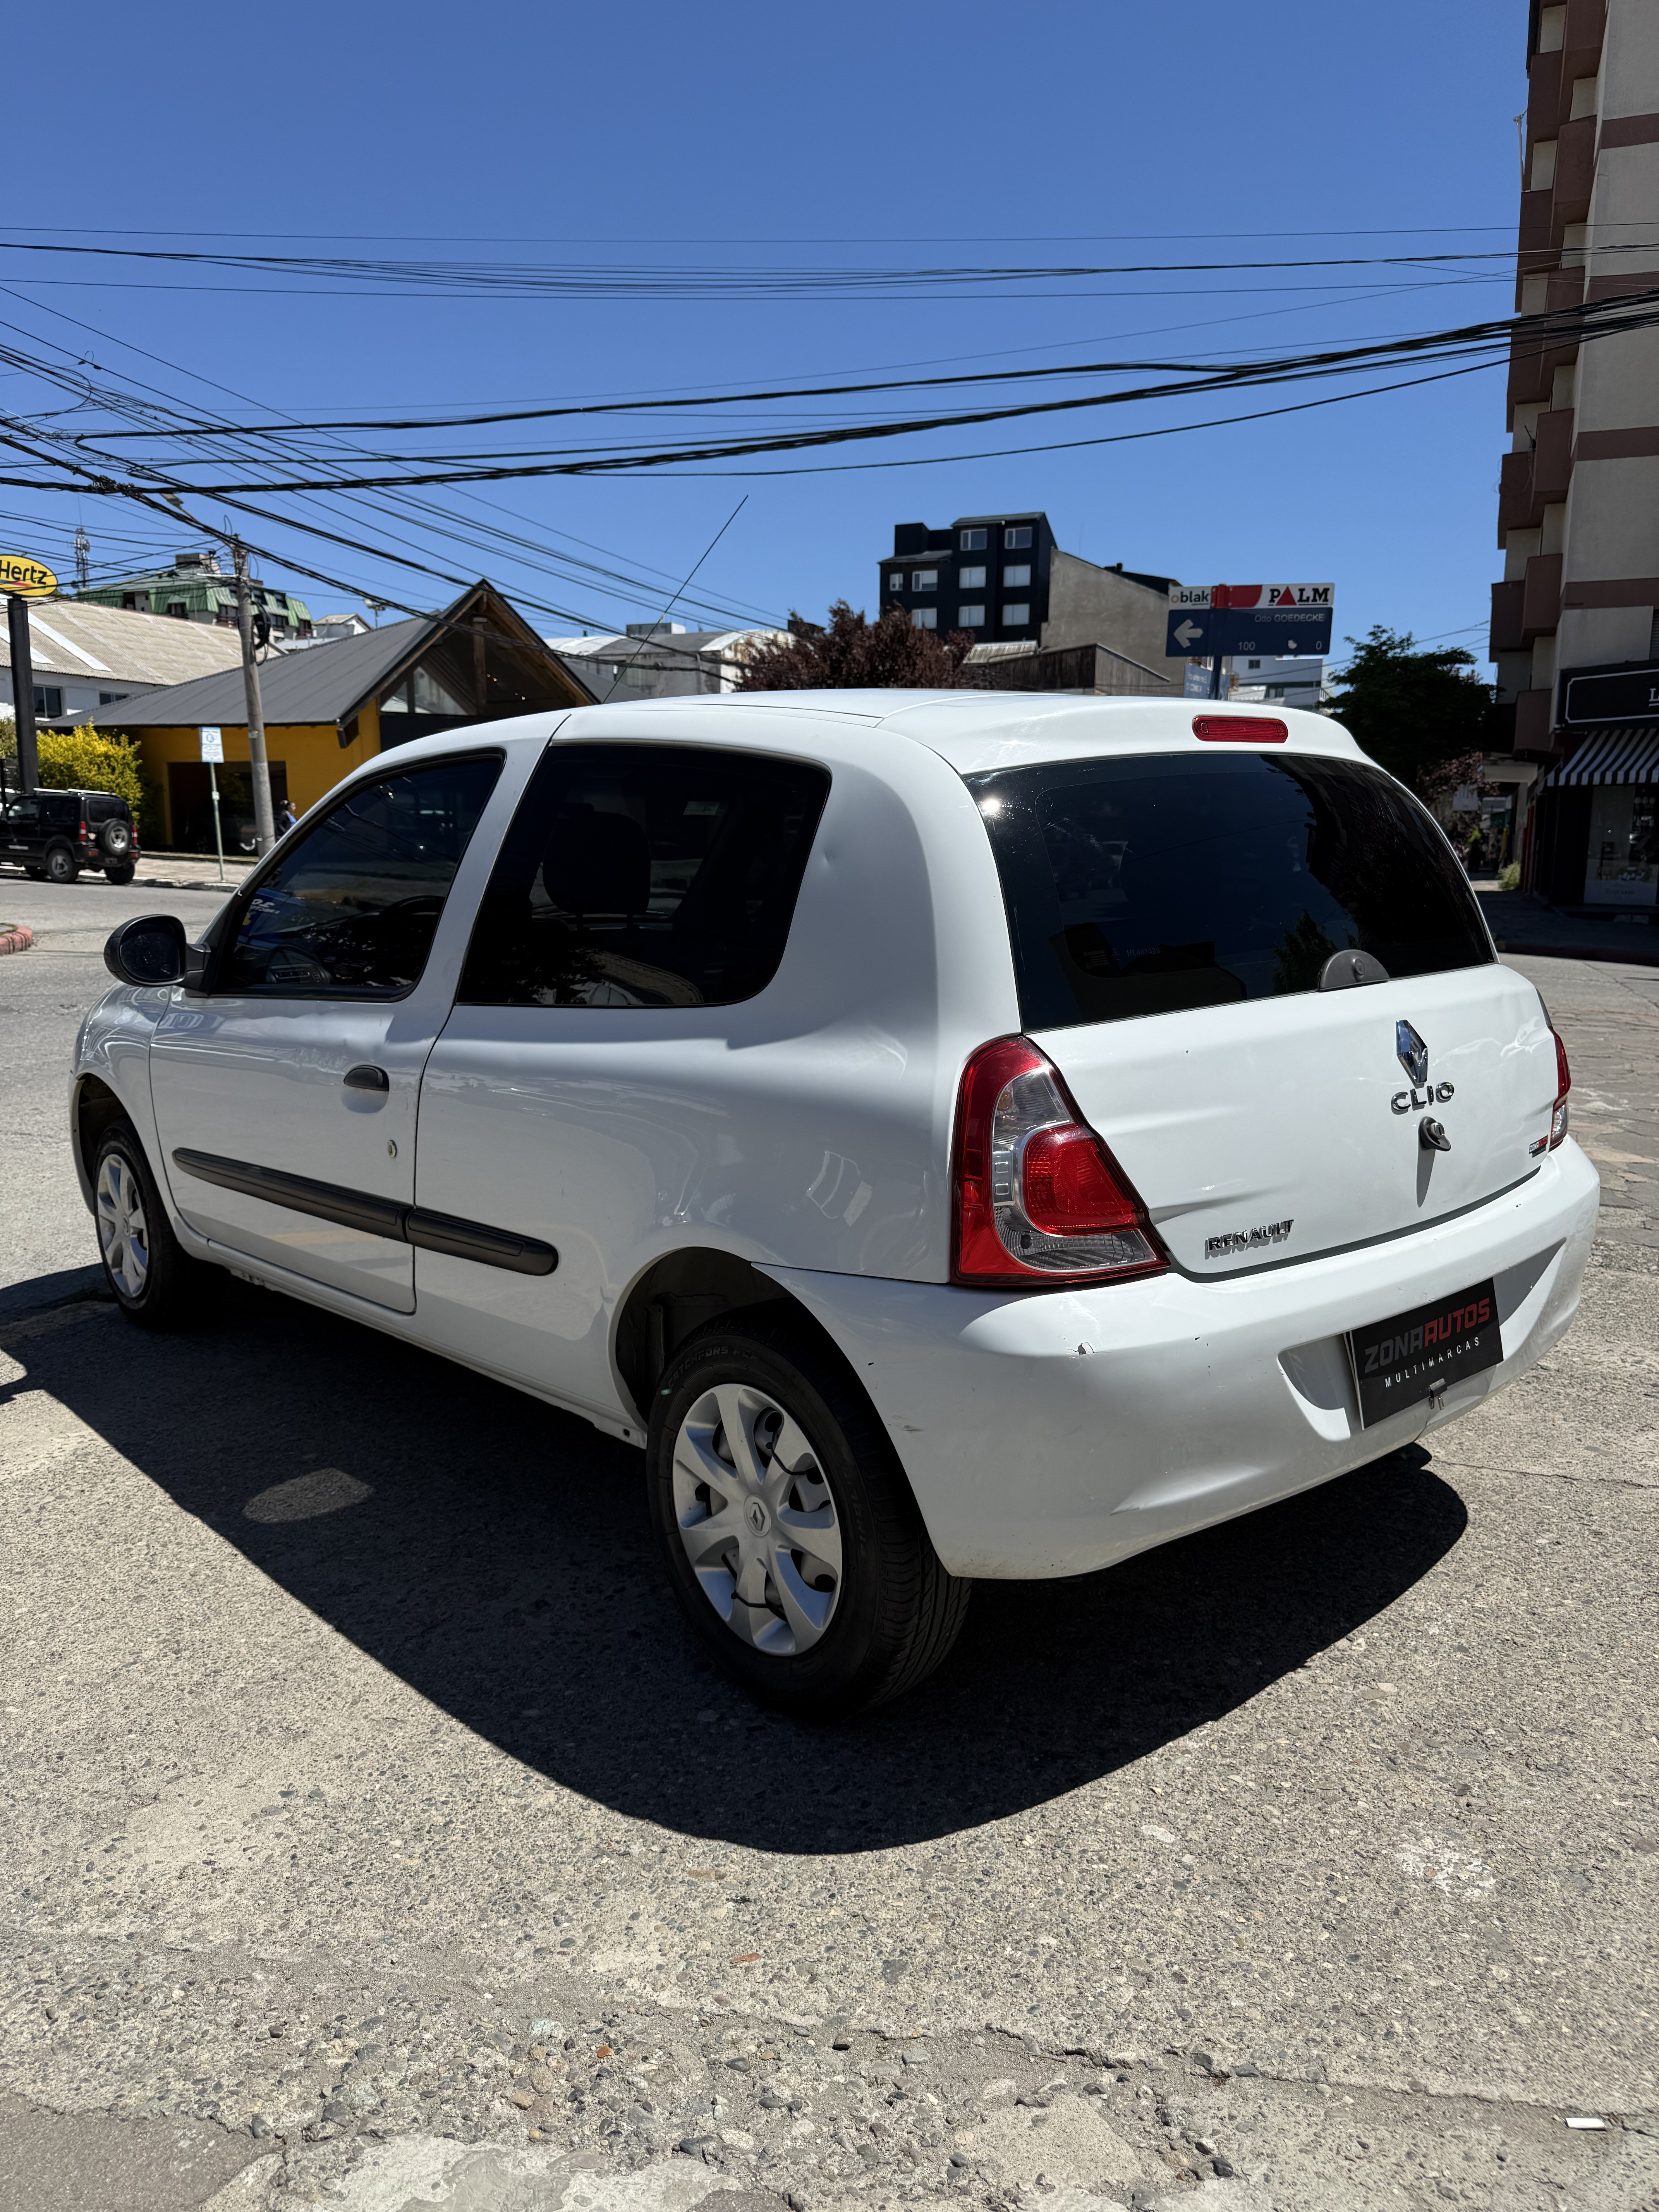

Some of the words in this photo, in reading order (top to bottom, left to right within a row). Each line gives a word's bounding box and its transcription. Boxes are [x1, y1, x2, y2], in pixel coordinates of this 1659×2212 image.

[0, 560, 47, 585] Hertz
[1171, 591, 1209, 603] oblak
[1254, 615, 1272, 623] Otto
[1274, 613, 1324, 622] GOEDECKE
[1238, 641, 1255, 651] 100
[1316, 641, 1322, 650] 0
[1649, 687, 1659, 702] L
[1391, 1082, 1455, 1110] CLIO
[1204, 1219, 1294, 1252] RENAULT
[1384, 1337, 1480, 1388] MULTIMARCAS
